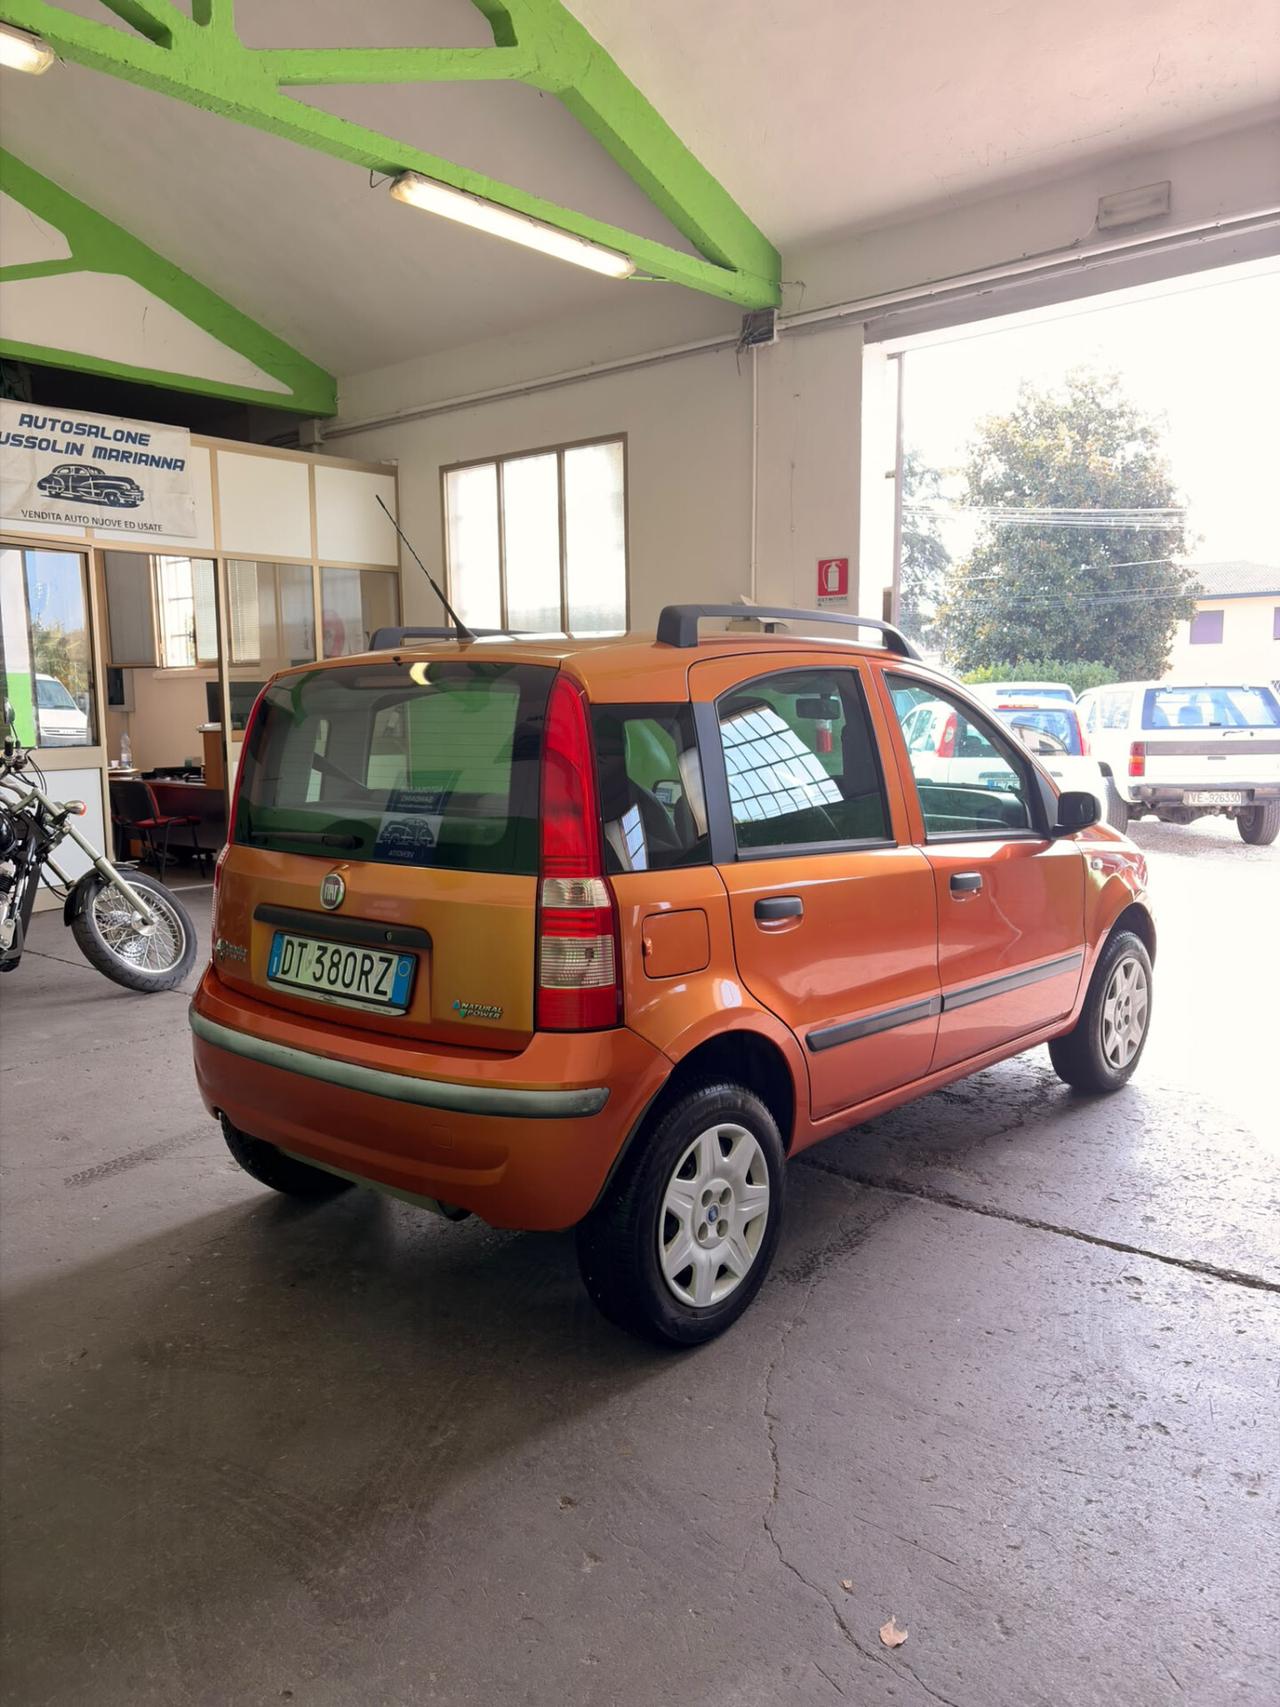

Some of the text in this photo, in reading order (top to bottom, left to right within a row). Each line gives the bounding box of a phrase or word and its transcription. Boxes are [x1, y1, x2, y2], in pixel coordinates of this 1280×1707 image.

[18, 413, 151, 446] AUTOSALONE
[92, 445, 186, 472] MARIANNA
[21, 509, 163, 532] VENDITA AUTO NUOVE ED USATE
[280, 940, 308, 978] DT
[312, 944, 393, 997] 380RZ
[461, 1002, 503, 1013] NATURAL
[465, 1009, 501, 1019] POWER
